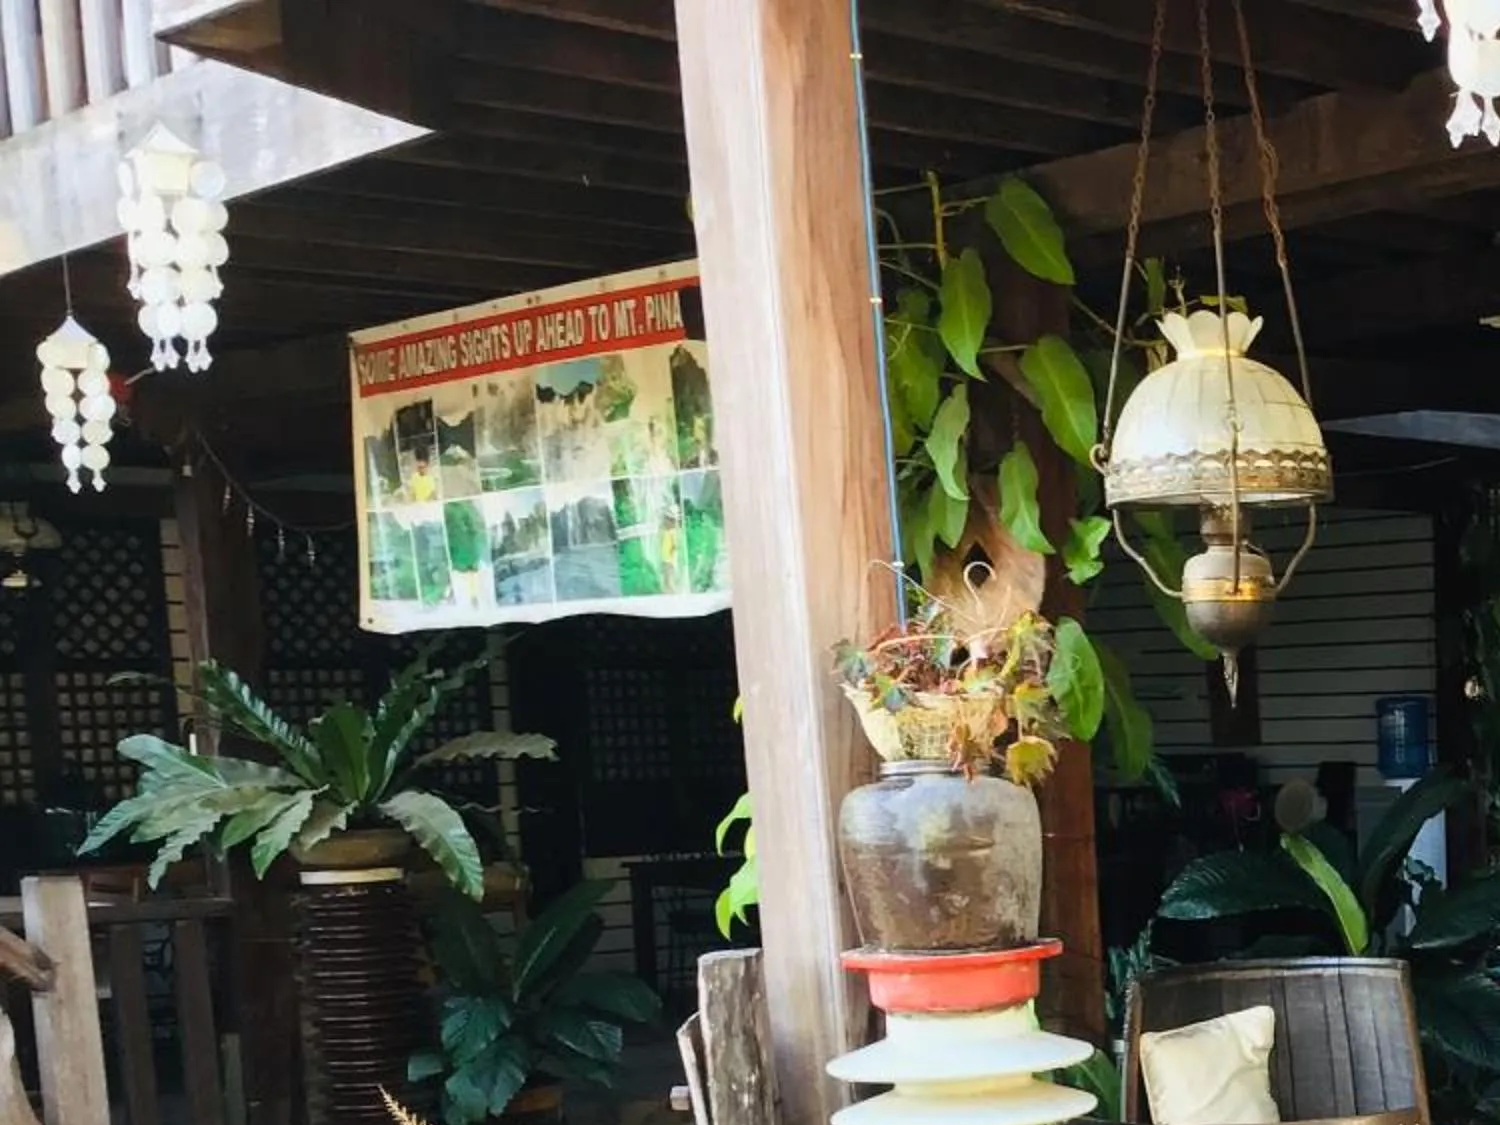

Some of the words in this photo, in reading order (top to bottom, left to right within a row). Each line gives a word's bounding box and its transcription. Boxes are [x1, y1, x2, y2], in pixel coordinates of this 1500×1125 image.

[400, 335, 457, 377] AMAZING
[459, 323, 511, 367] SIGHTS
[512, 319, 533, 356] UP
[536, 309, 585, 352] AHEAD
[588, 303, 611, 342] TO
[613, 299, 645, 338] MT.
